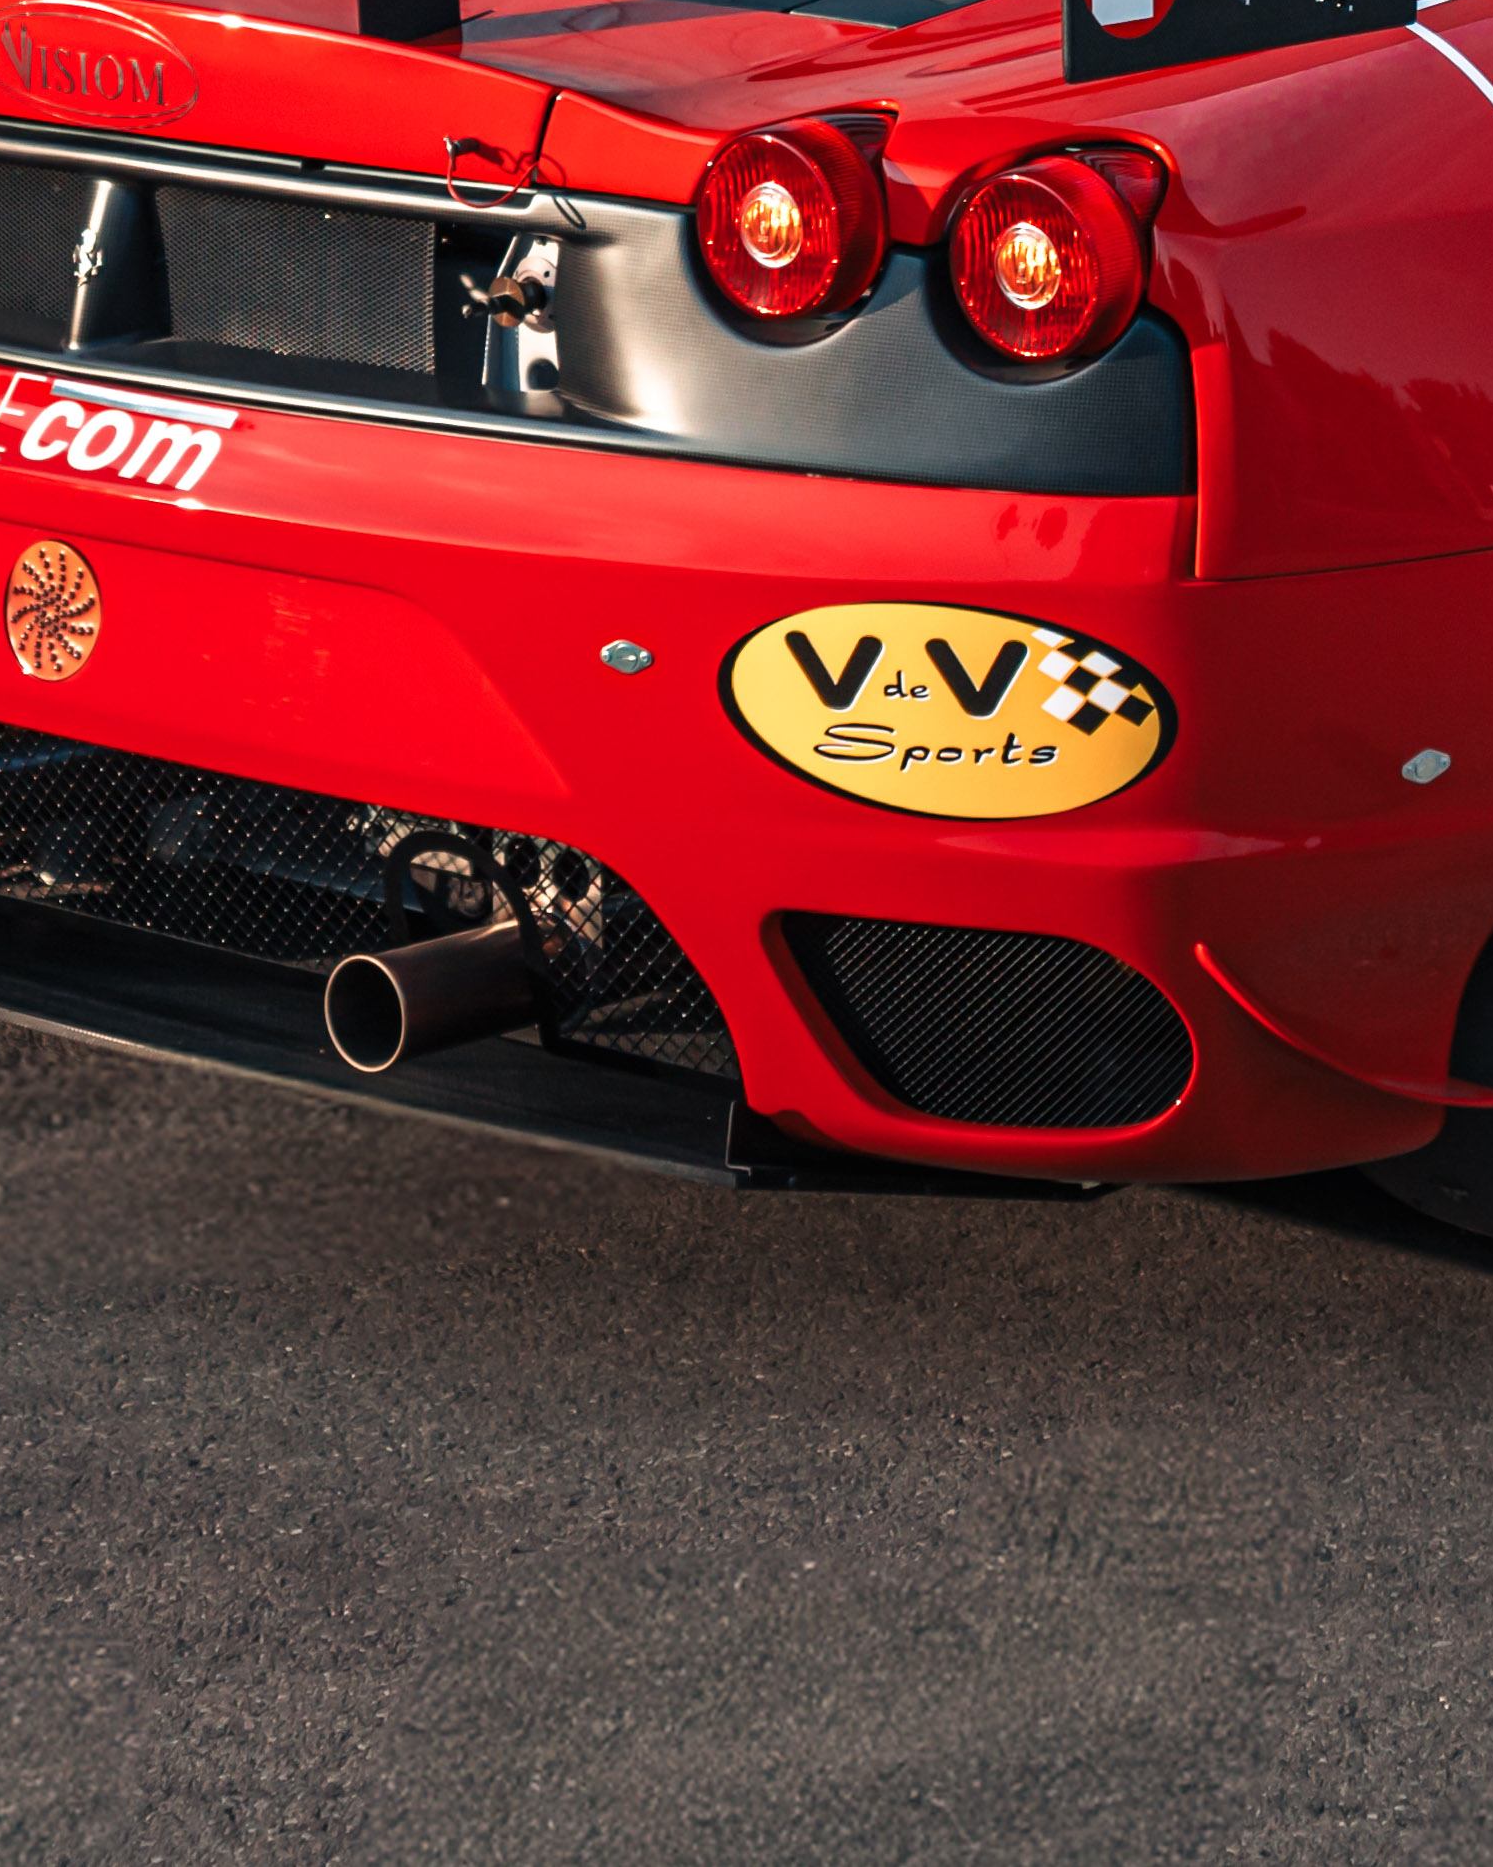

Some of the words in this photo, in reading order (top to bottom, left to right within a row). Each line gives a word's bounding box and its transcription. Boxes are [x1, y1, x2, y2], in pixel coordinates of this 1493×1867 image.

[1, 21, 169, 106] VISIOM
[785, 630, 884, 713] V
[884, 670, 930, 701] de
[925, 638, 1030, 720] V
[813, 723, 1059, 772] Sports
